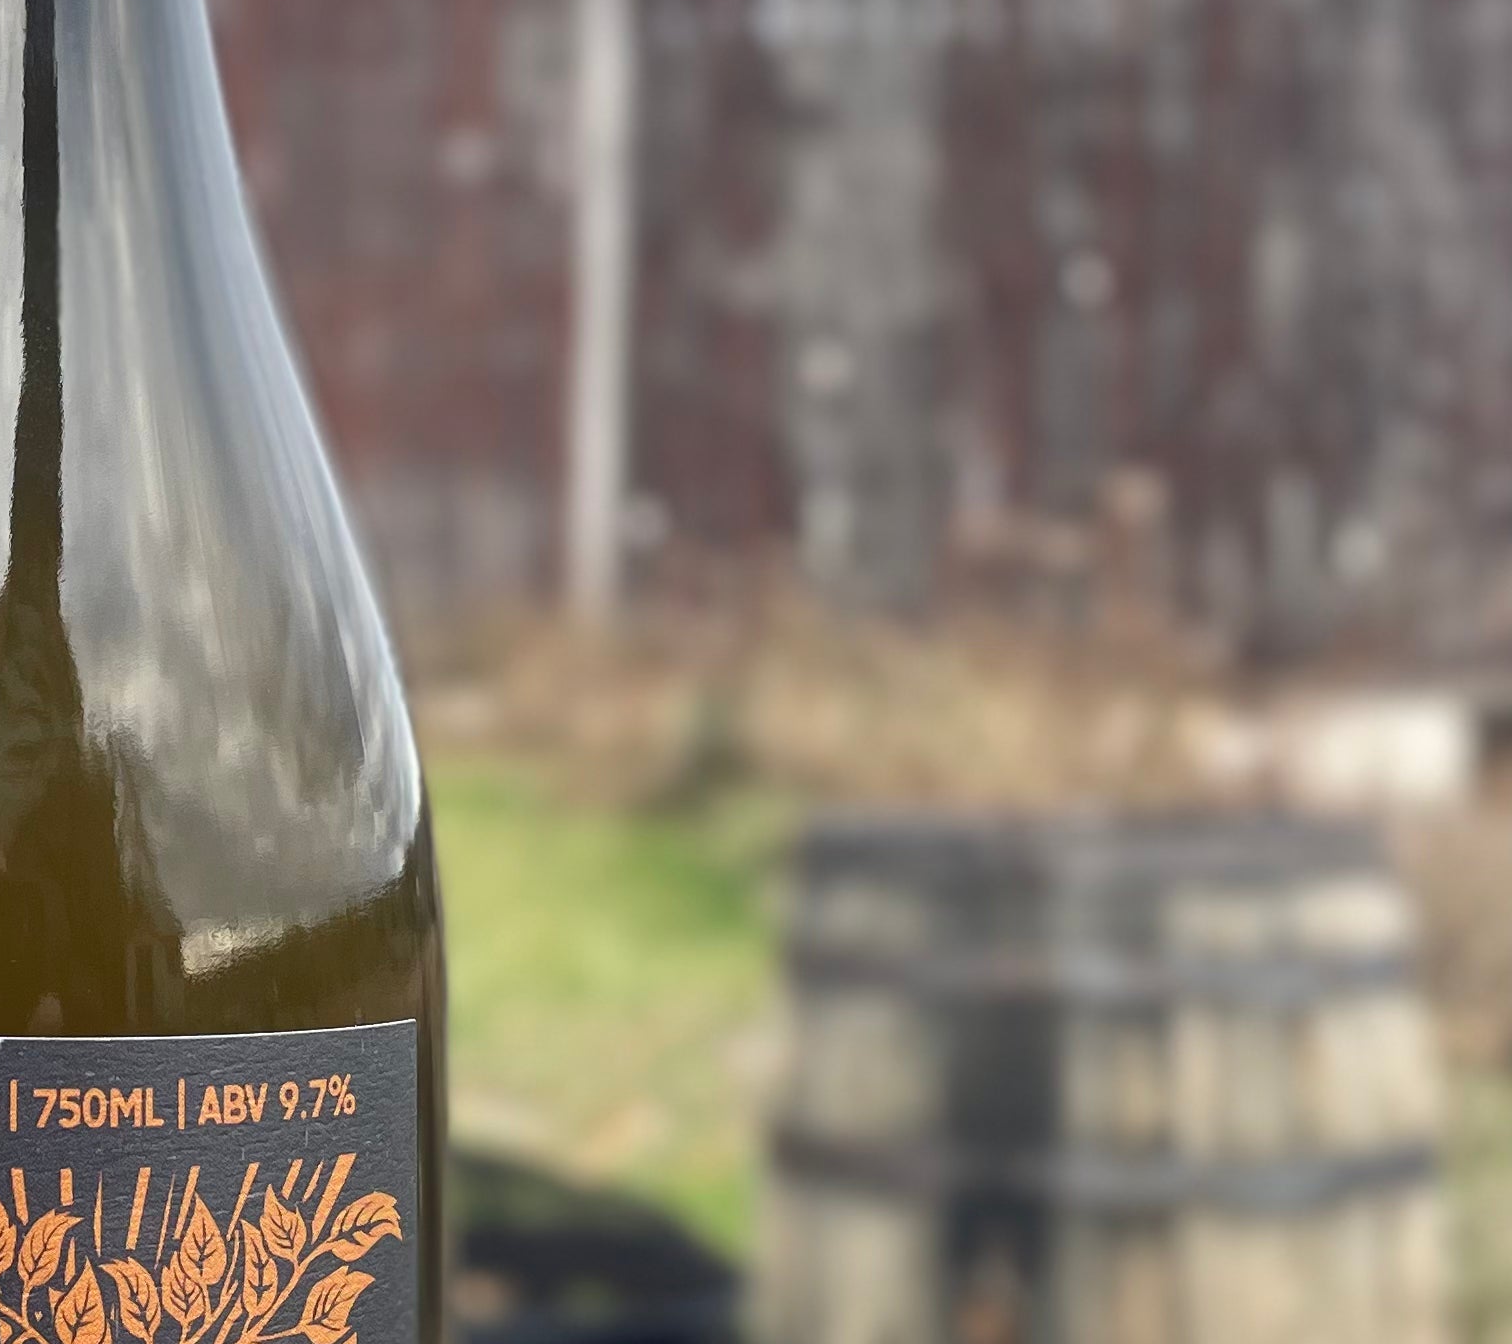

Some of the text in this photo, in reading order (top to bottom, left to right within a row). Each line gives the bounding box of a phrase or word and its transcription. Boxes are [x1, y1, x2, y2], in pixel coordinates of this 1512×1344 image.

[33, 1088, 164, 1128] 750ML
[198, 1083, 268, 1126] ABV
[280, 1073, 356, 1121] 9.7%
